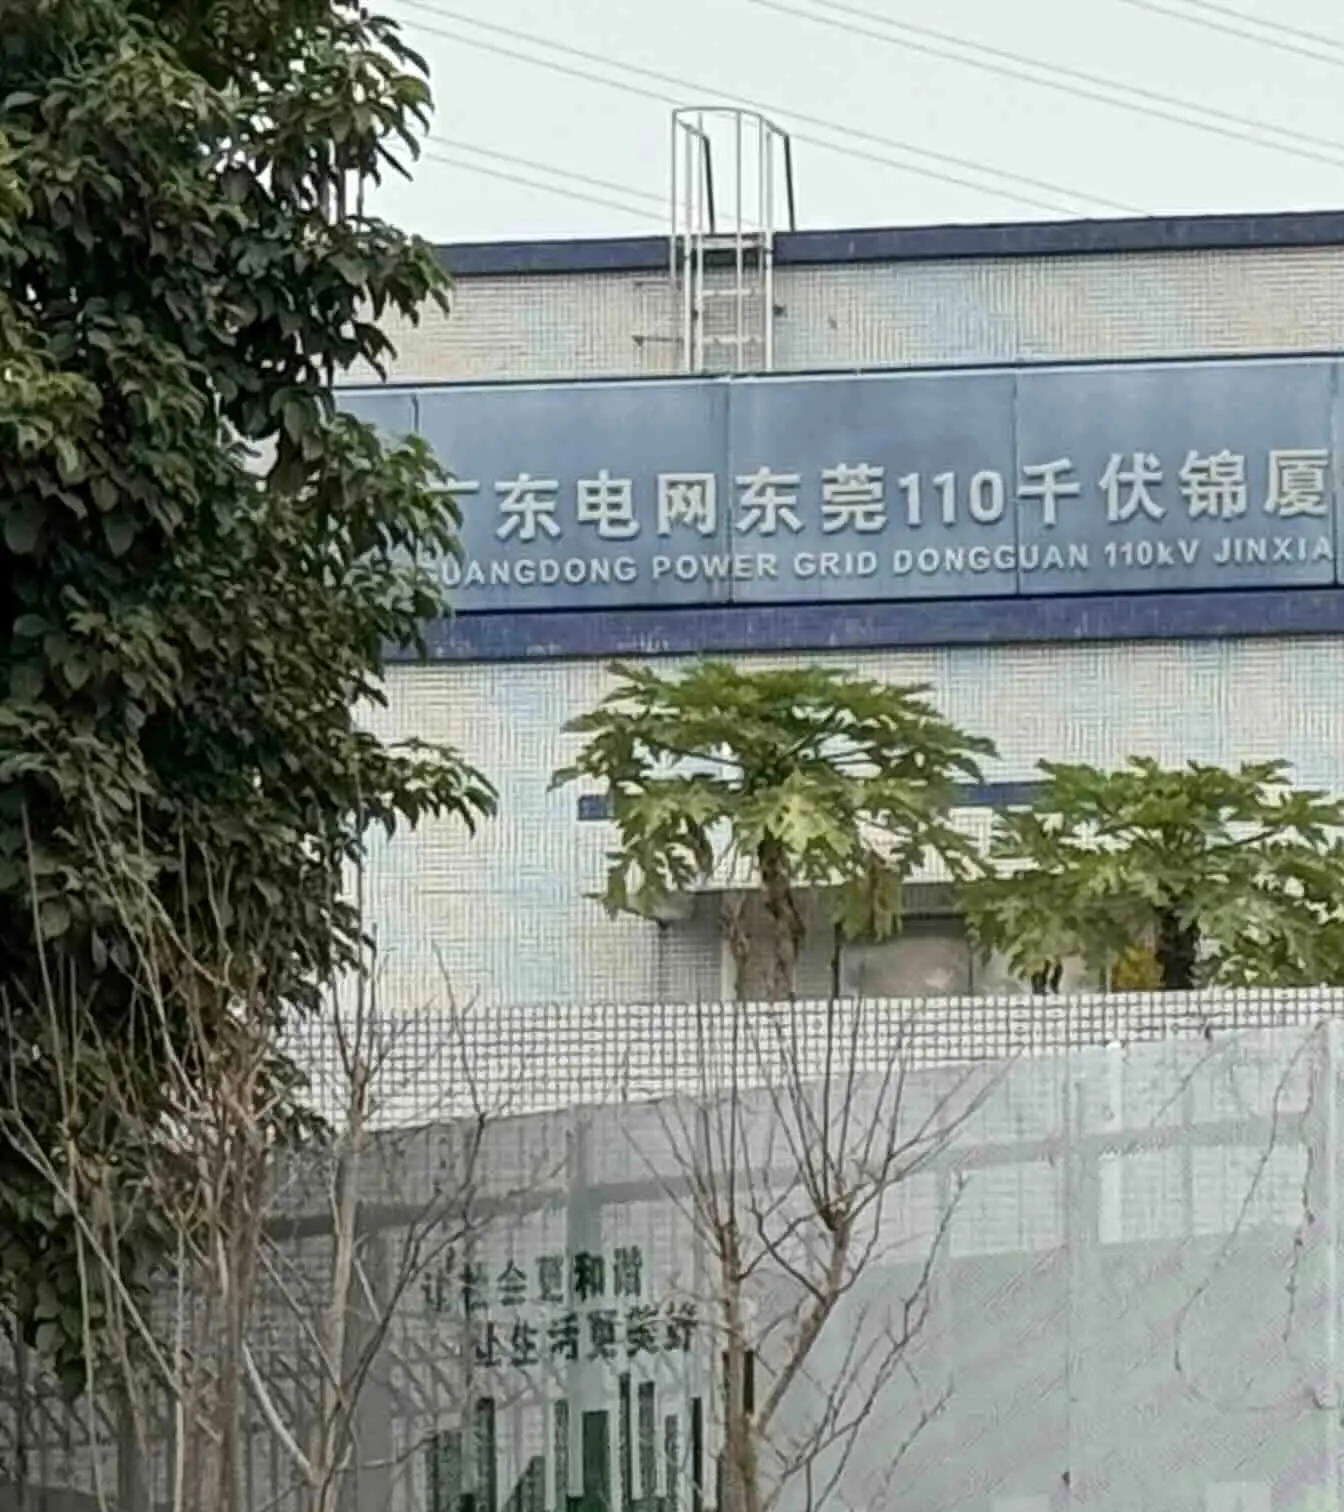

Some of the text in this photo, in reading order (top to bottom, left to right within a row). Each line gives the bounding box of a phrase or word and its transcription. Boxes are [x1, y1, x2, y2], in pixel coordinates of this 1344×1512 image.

[424, 553, 638, 585] UANGDONG
[651, 551, 778, 581] POWER
[793, 549, 877, 578] GRID
[892, 543, 1090, 576] DONGGUAN
[1213, 534, 1334, 565] JINXIA
